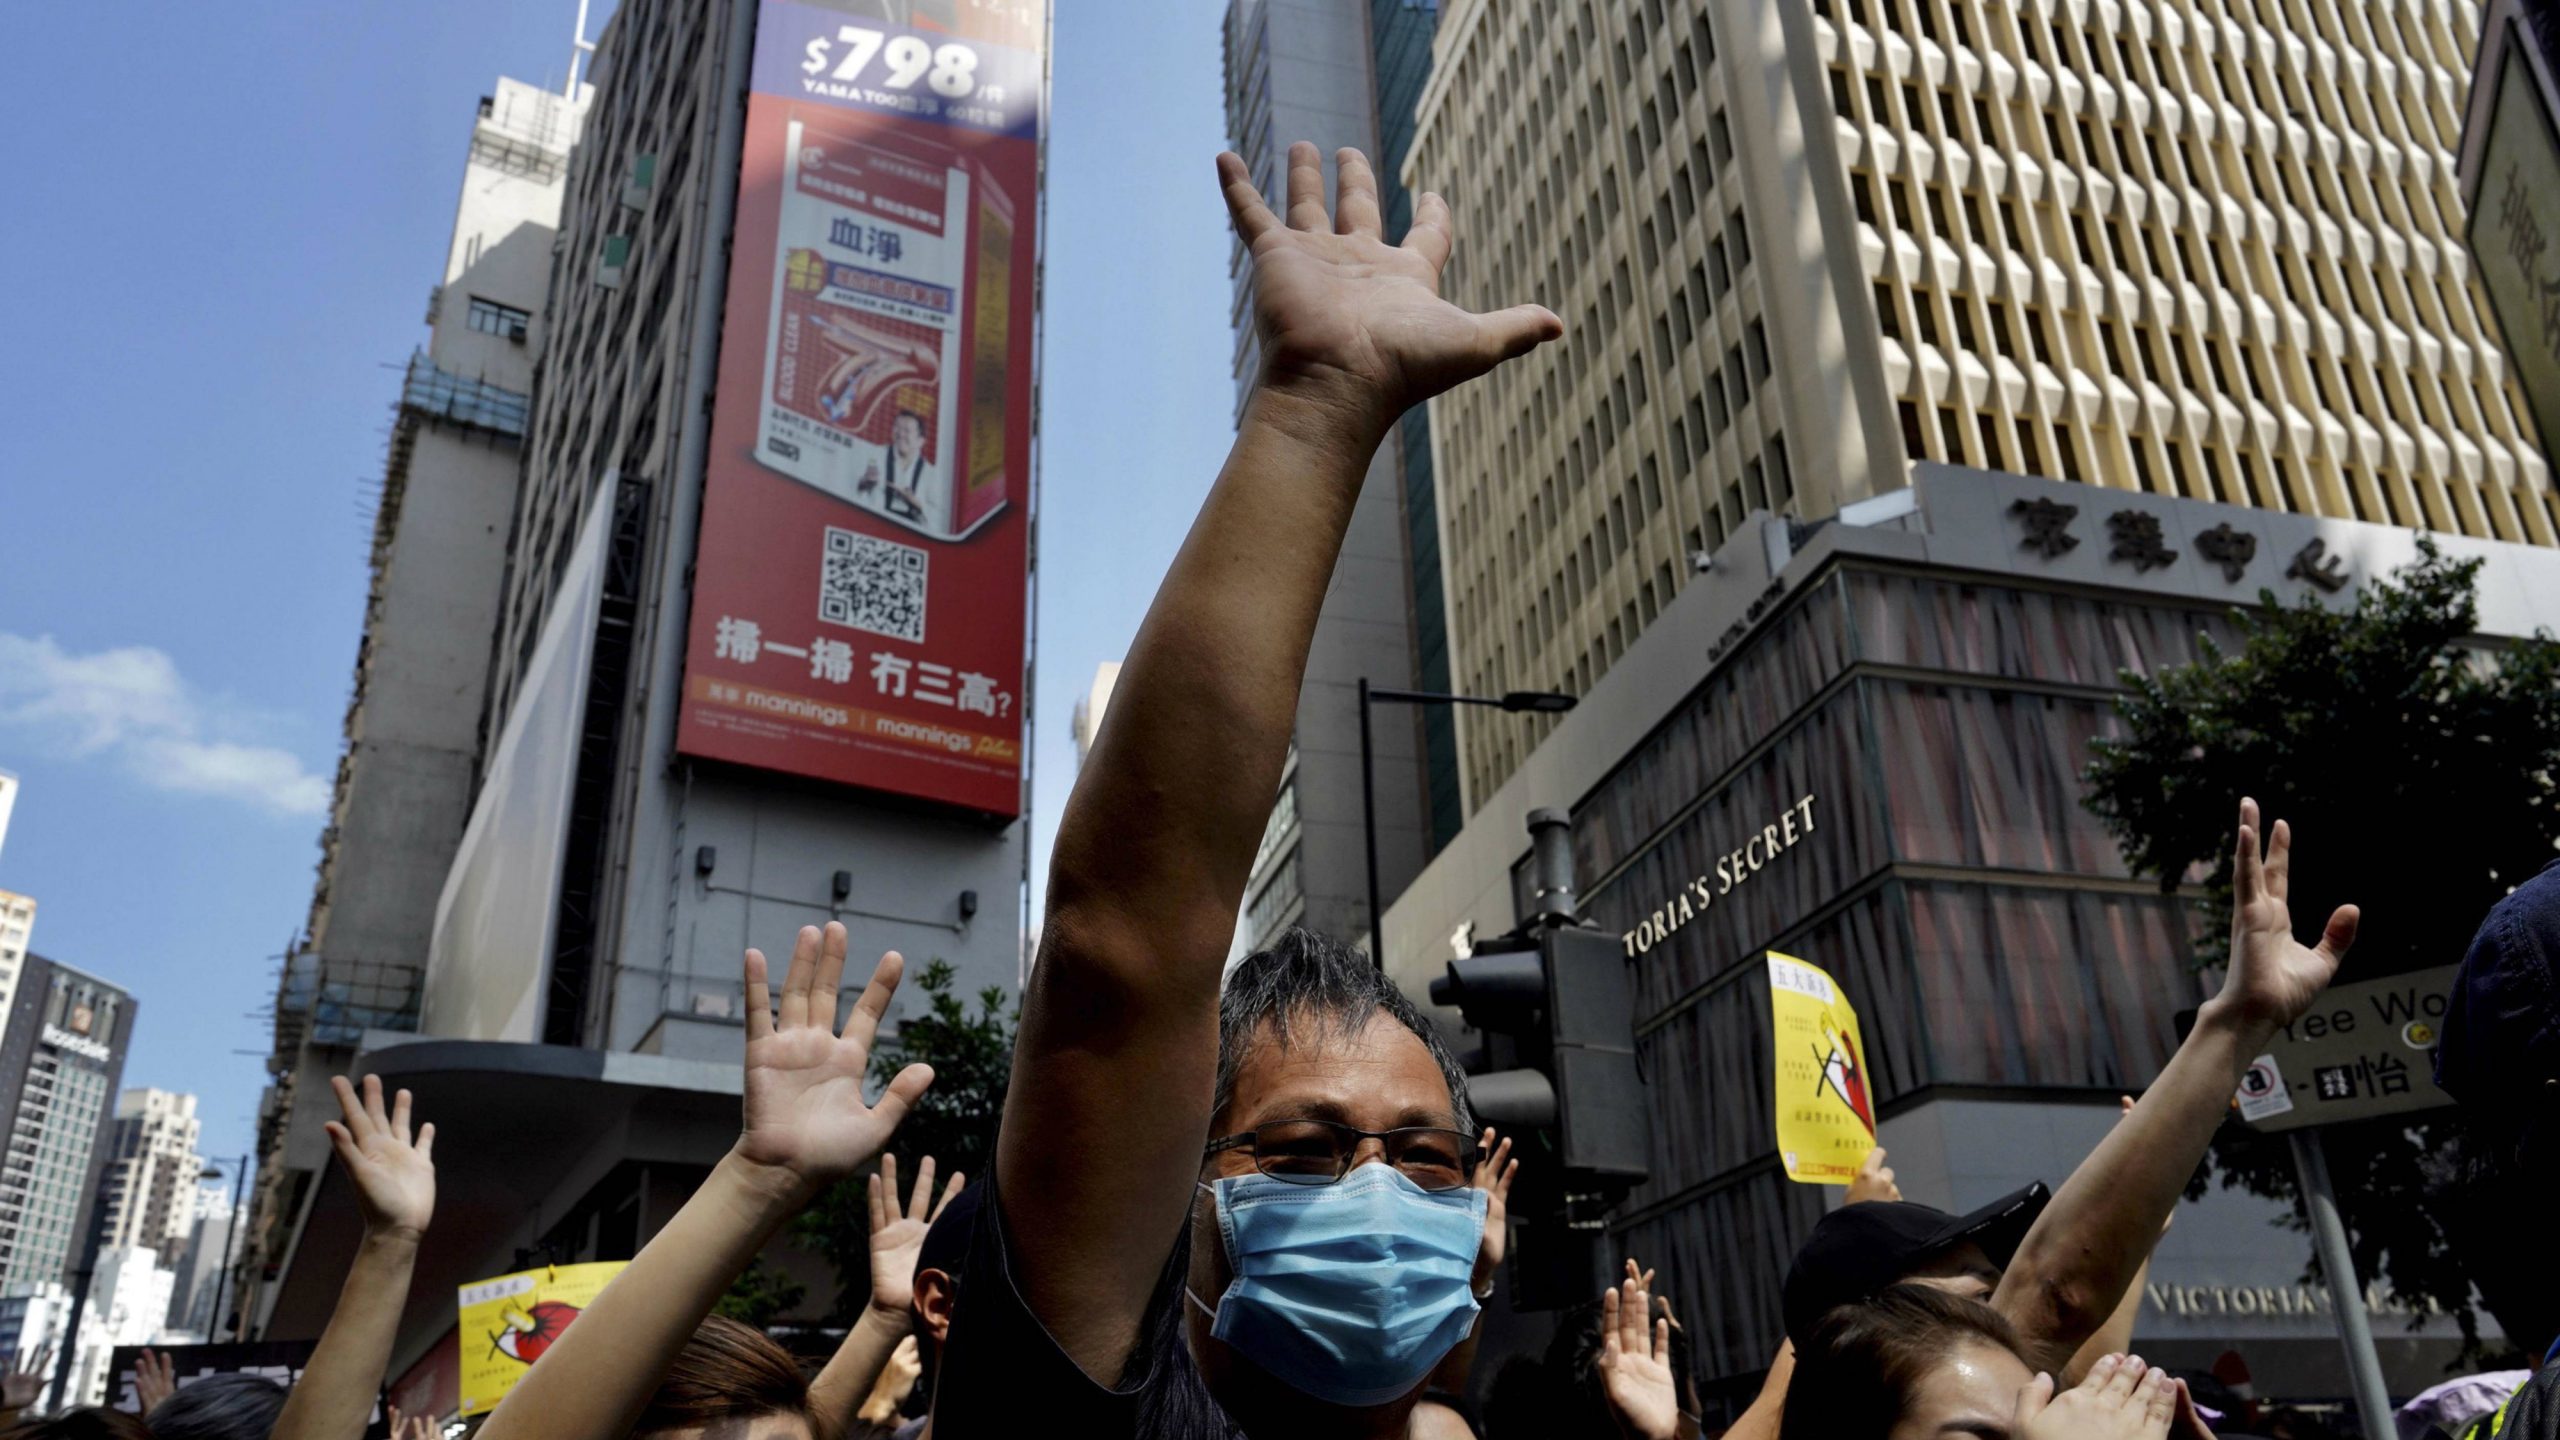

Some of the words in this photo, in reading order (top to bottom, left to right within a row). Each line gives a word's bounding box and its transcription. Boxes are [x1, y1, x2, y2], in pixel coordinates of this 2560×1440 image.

[828, 217, 902, 263] 血淨
[714, 615, 854, 684] 掃一掃
[745, 690, 849, 726] mannings
[876, 717, 971, 751] mannings
[1716, 794, 1815, 895] SECRET
[2370, 988, 2447, 1026] Wo
